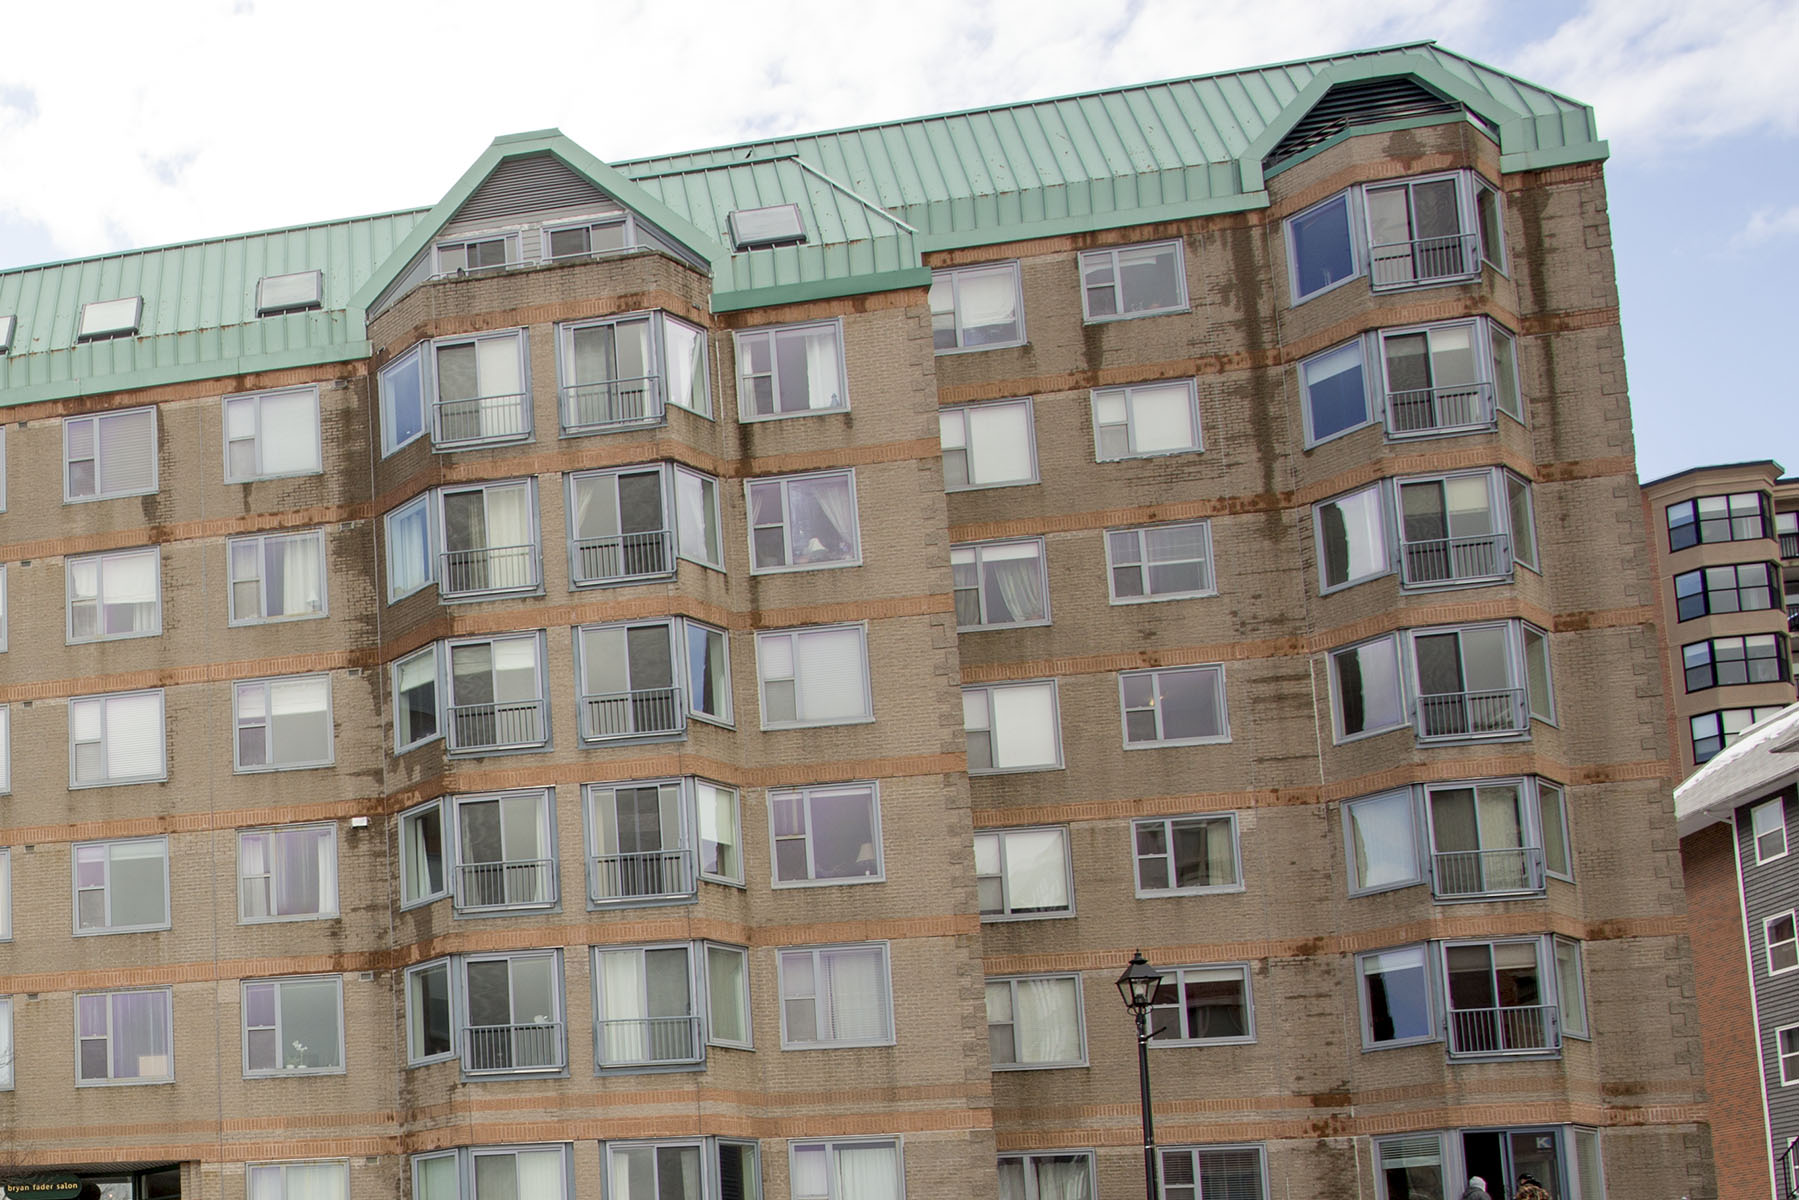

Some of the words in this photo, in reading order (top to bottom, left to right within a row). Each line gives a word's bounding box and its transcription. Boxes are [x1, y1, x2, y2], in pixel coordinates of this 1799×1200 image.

[7, 1184, 30, 1193] bryan
[32, 1183, 54, 1191] fader
[56, 1182, 78, 1190] salon
